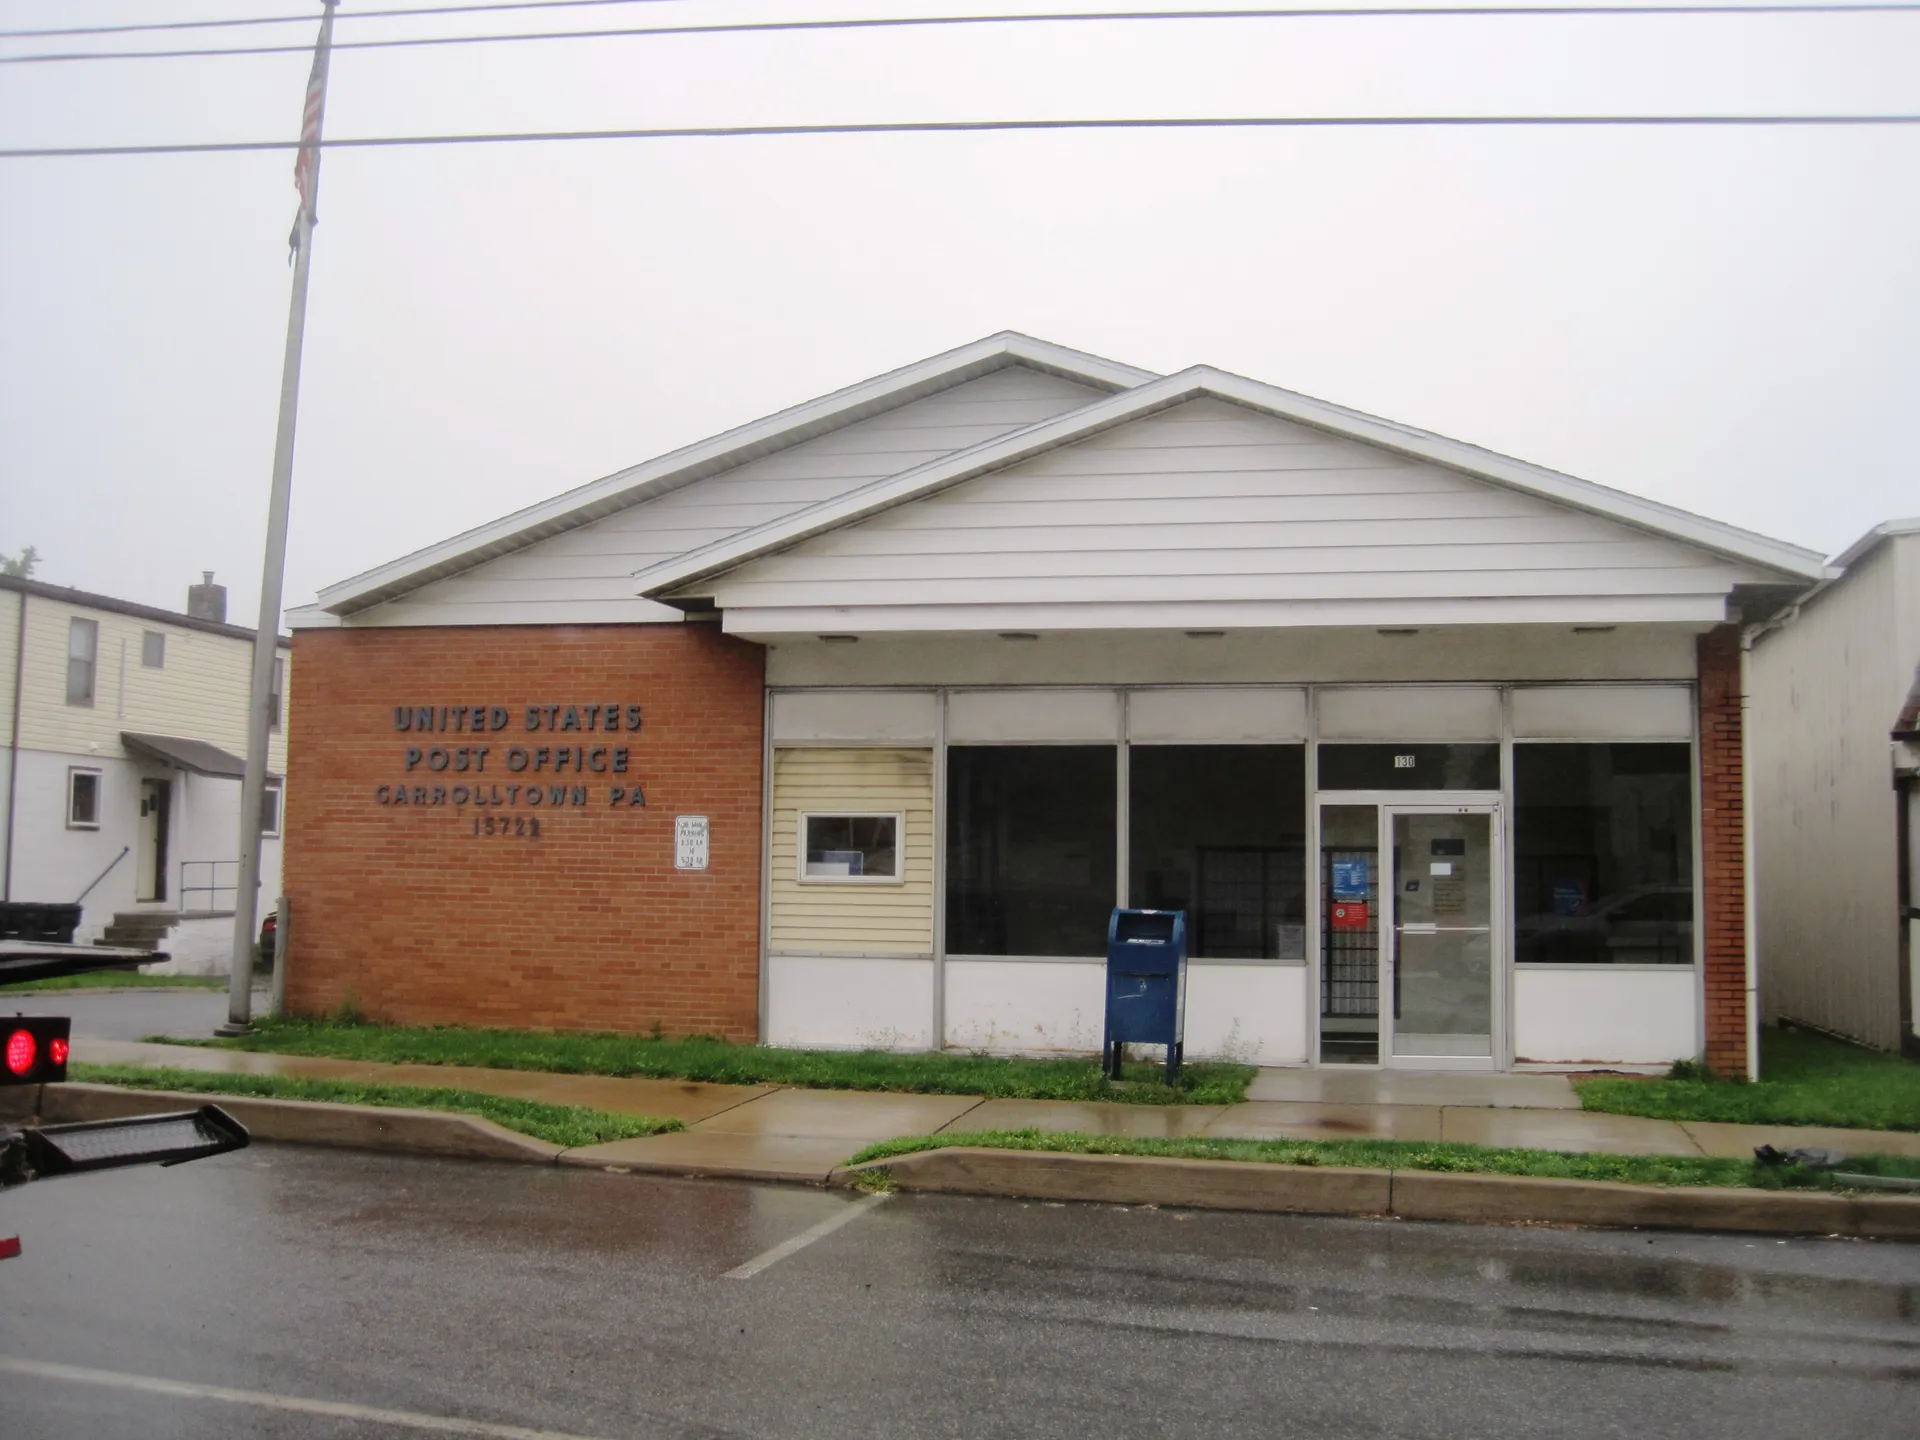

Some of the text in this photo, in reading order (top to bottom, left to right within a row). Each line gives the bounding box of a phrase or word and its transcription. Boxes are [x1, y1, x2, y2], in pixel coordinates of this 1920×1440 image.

[394, 705, 642, 732] UNITED STATES
[405, 747, 629, 772] POST OFFICE
[1395, 756, 1414, 767] 130
[376, 785, 646, 807] CARROLLTOWN PA
[474, 817, 541, 837] 15722
